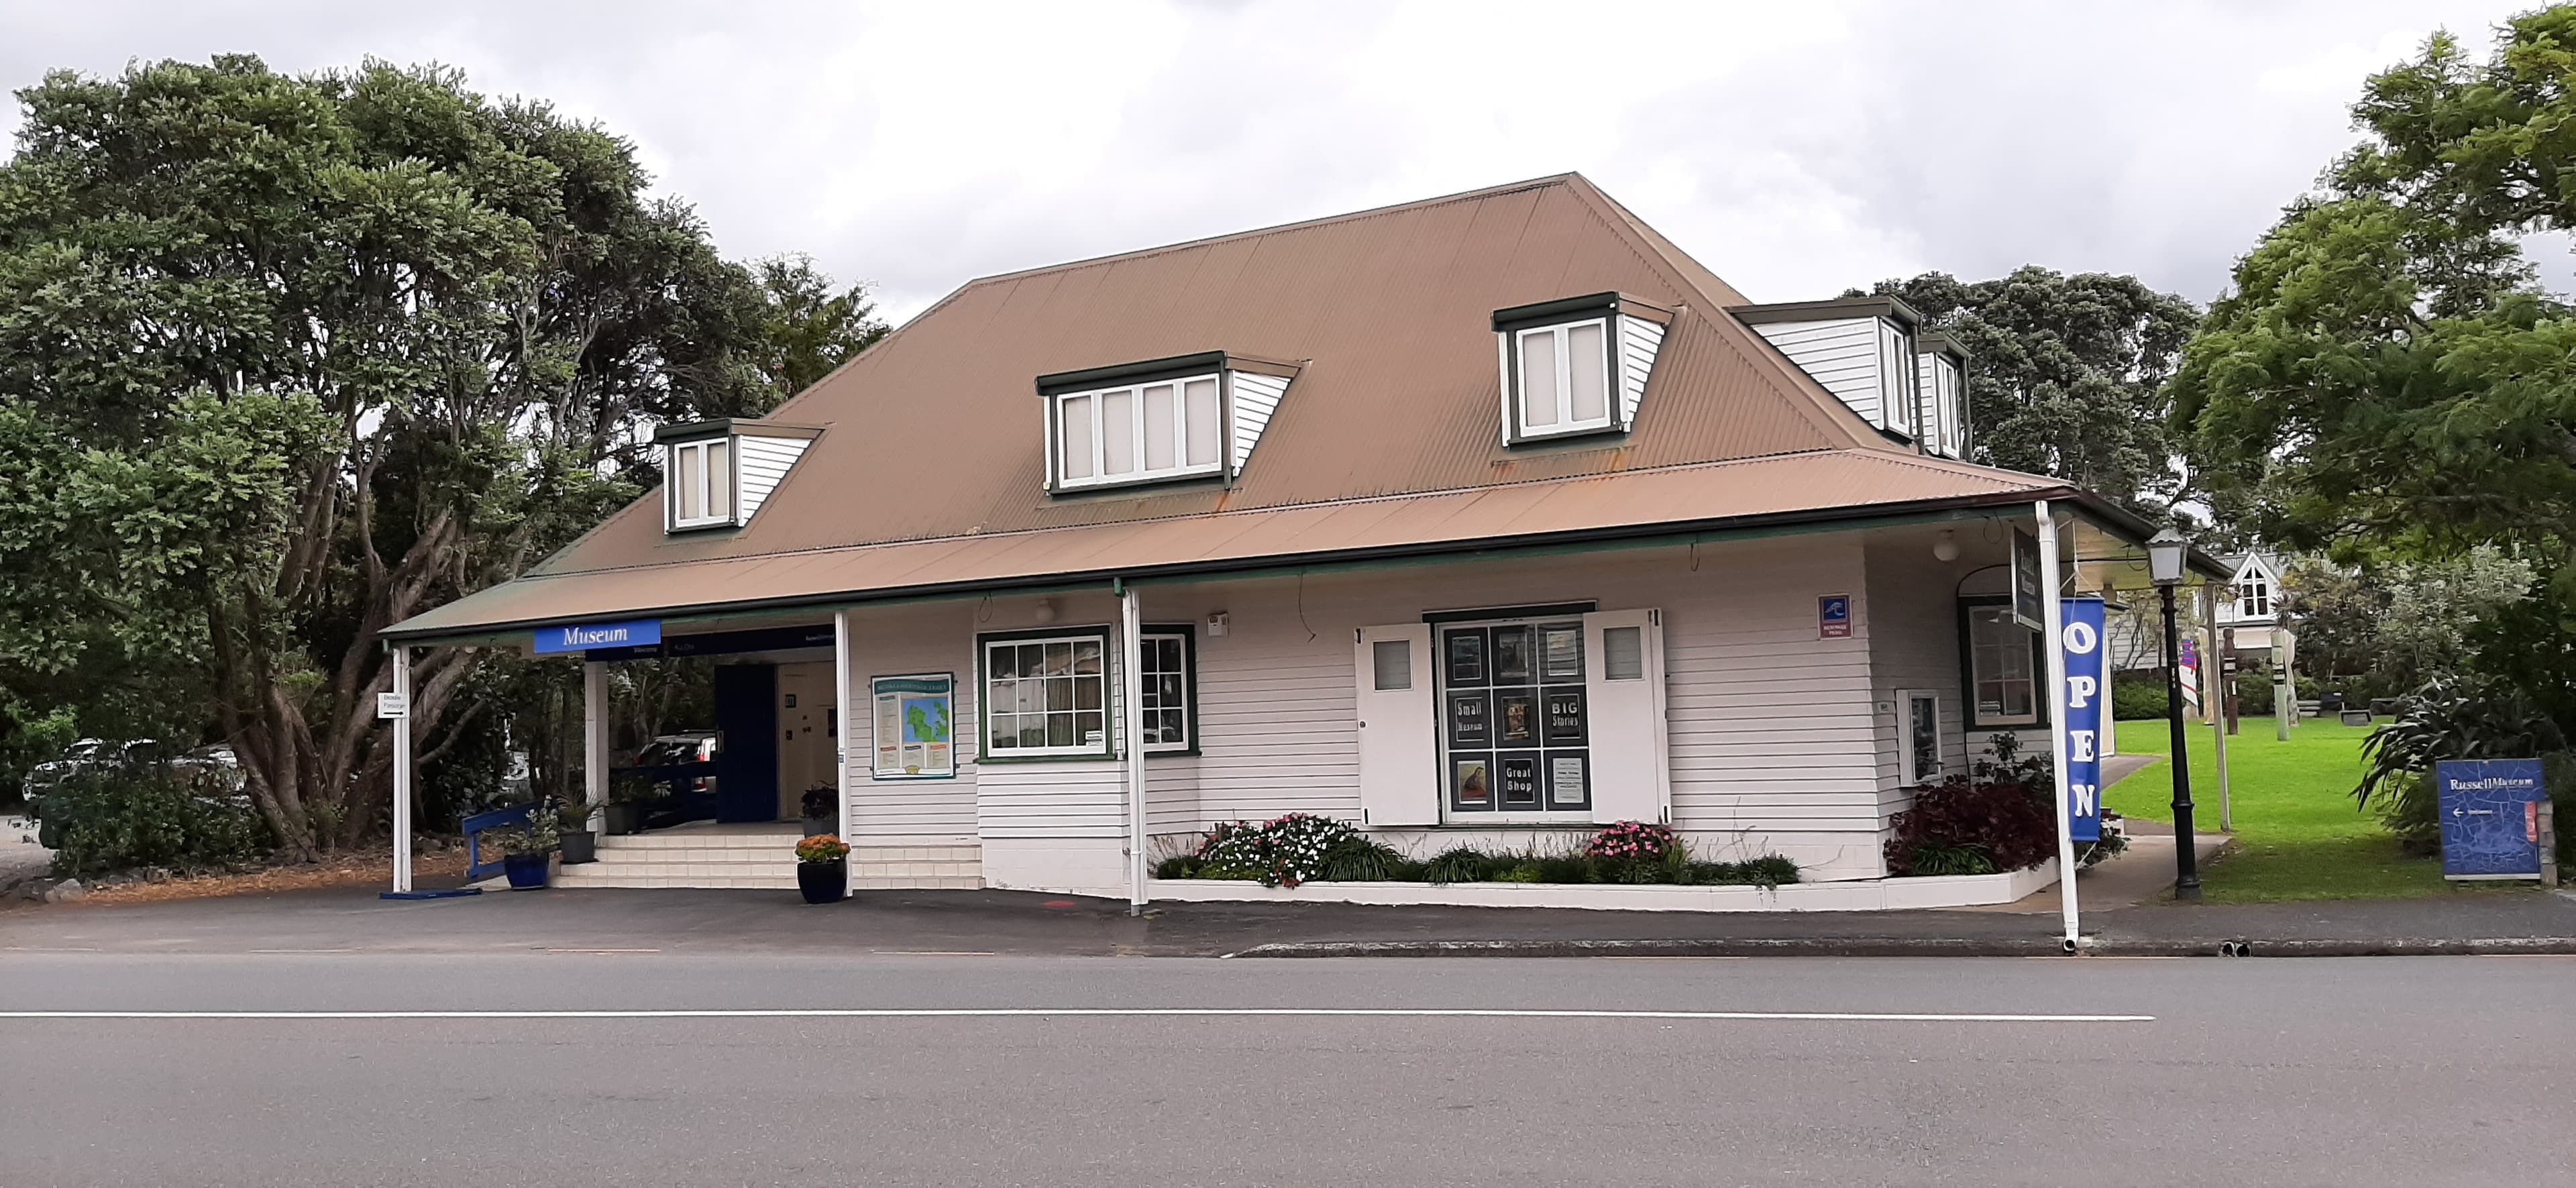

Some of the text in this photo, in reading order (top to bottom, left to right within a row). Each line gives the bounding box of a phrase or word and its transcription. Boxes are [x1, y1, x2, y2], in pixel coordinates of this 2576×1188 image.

[564, 627, 628, 645] Museum
[1457, 701, 1482, 716] Small
[1552, 702, 1578, 714] BIG
[1552, 714, 1578, 726] Stories
[2062, 621, 2097, 817] OPEN
[1506, 767, 1531, 778] Great
[1507, 780, 1532, 792] Shop
